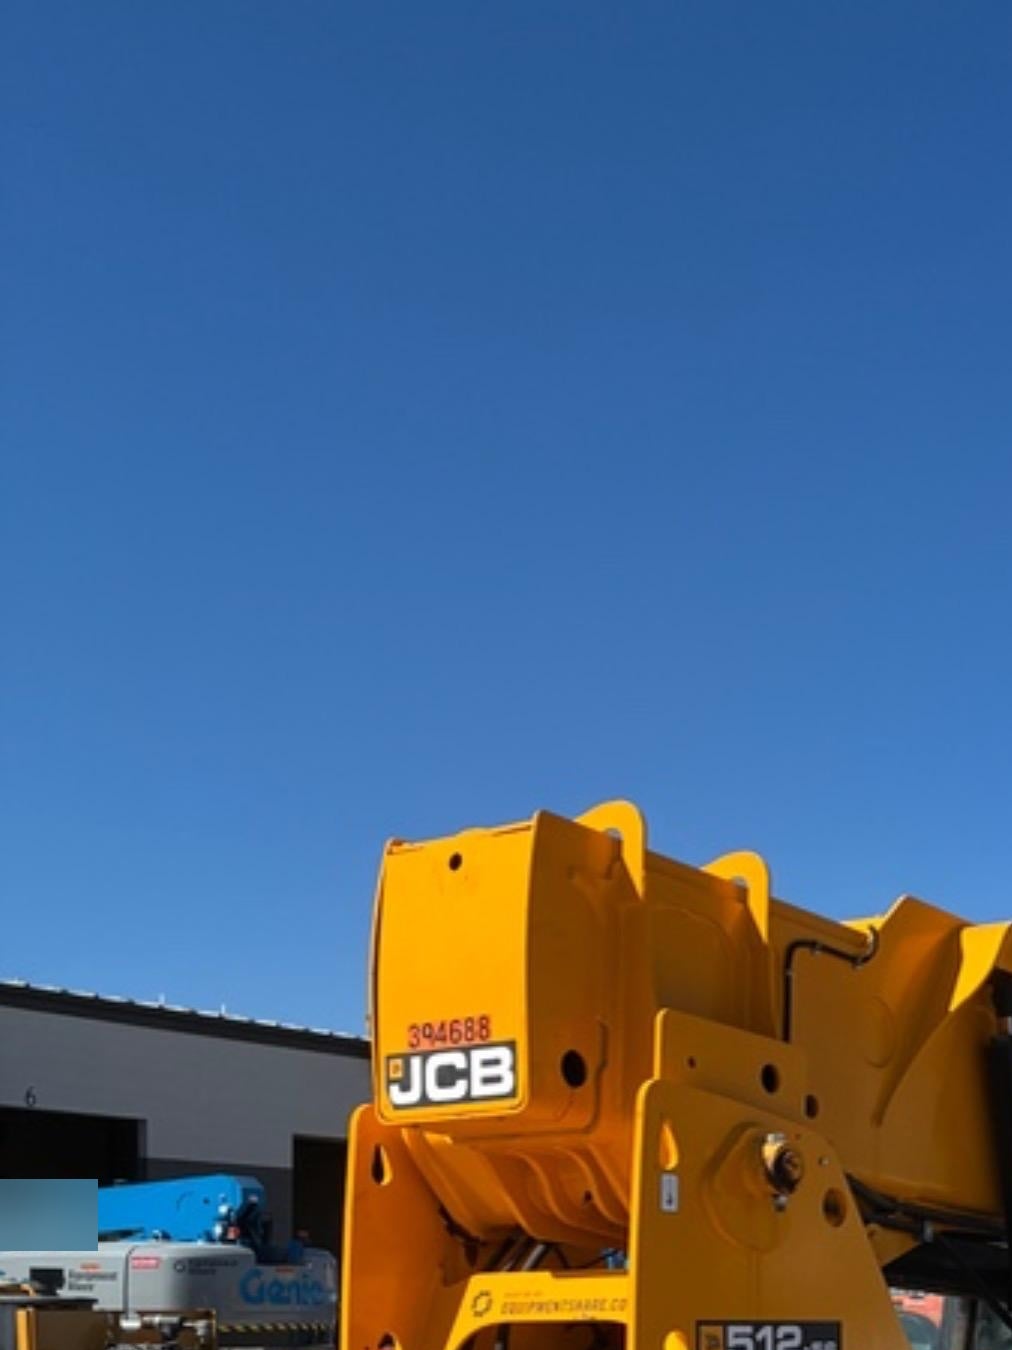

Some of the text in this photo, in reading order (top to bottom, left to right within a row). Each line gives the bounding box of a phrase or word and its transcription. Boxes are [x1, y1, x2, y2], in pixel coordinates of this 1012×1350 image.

[408, 1015, 491, 1048] 394688
[389, 1046, 515, 1105] JCB
[25, 1086, 36, 1106] 6
[240, 1269, 324, 1305] Genie
